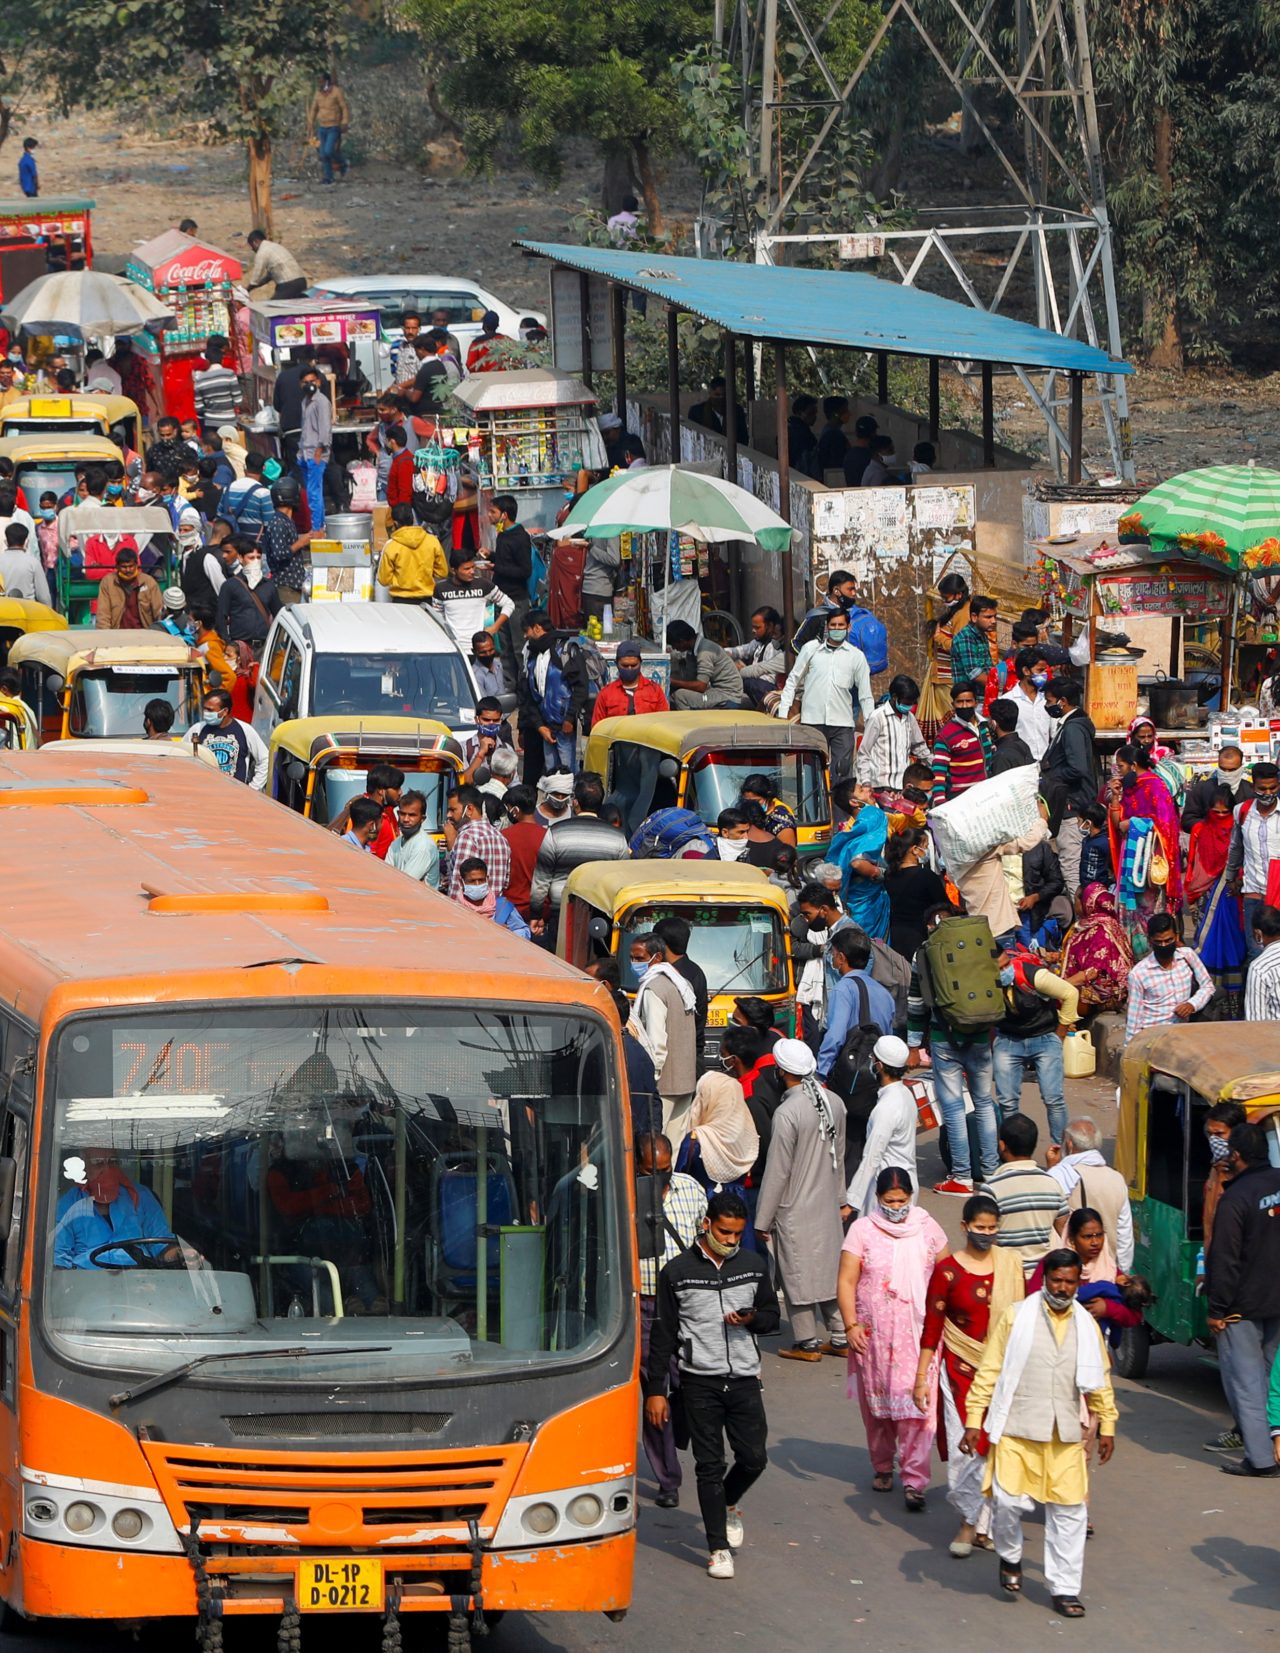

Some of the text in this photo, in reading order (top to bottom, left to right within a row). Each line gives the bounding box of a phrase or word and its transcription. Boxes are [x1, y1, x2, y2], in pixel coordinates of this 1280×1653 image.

[442, 588, 484, 599] VOLCANO
[314, 1564, 360, 1583] DL-1P
[311, 1586, 370, 1607] D-0212
